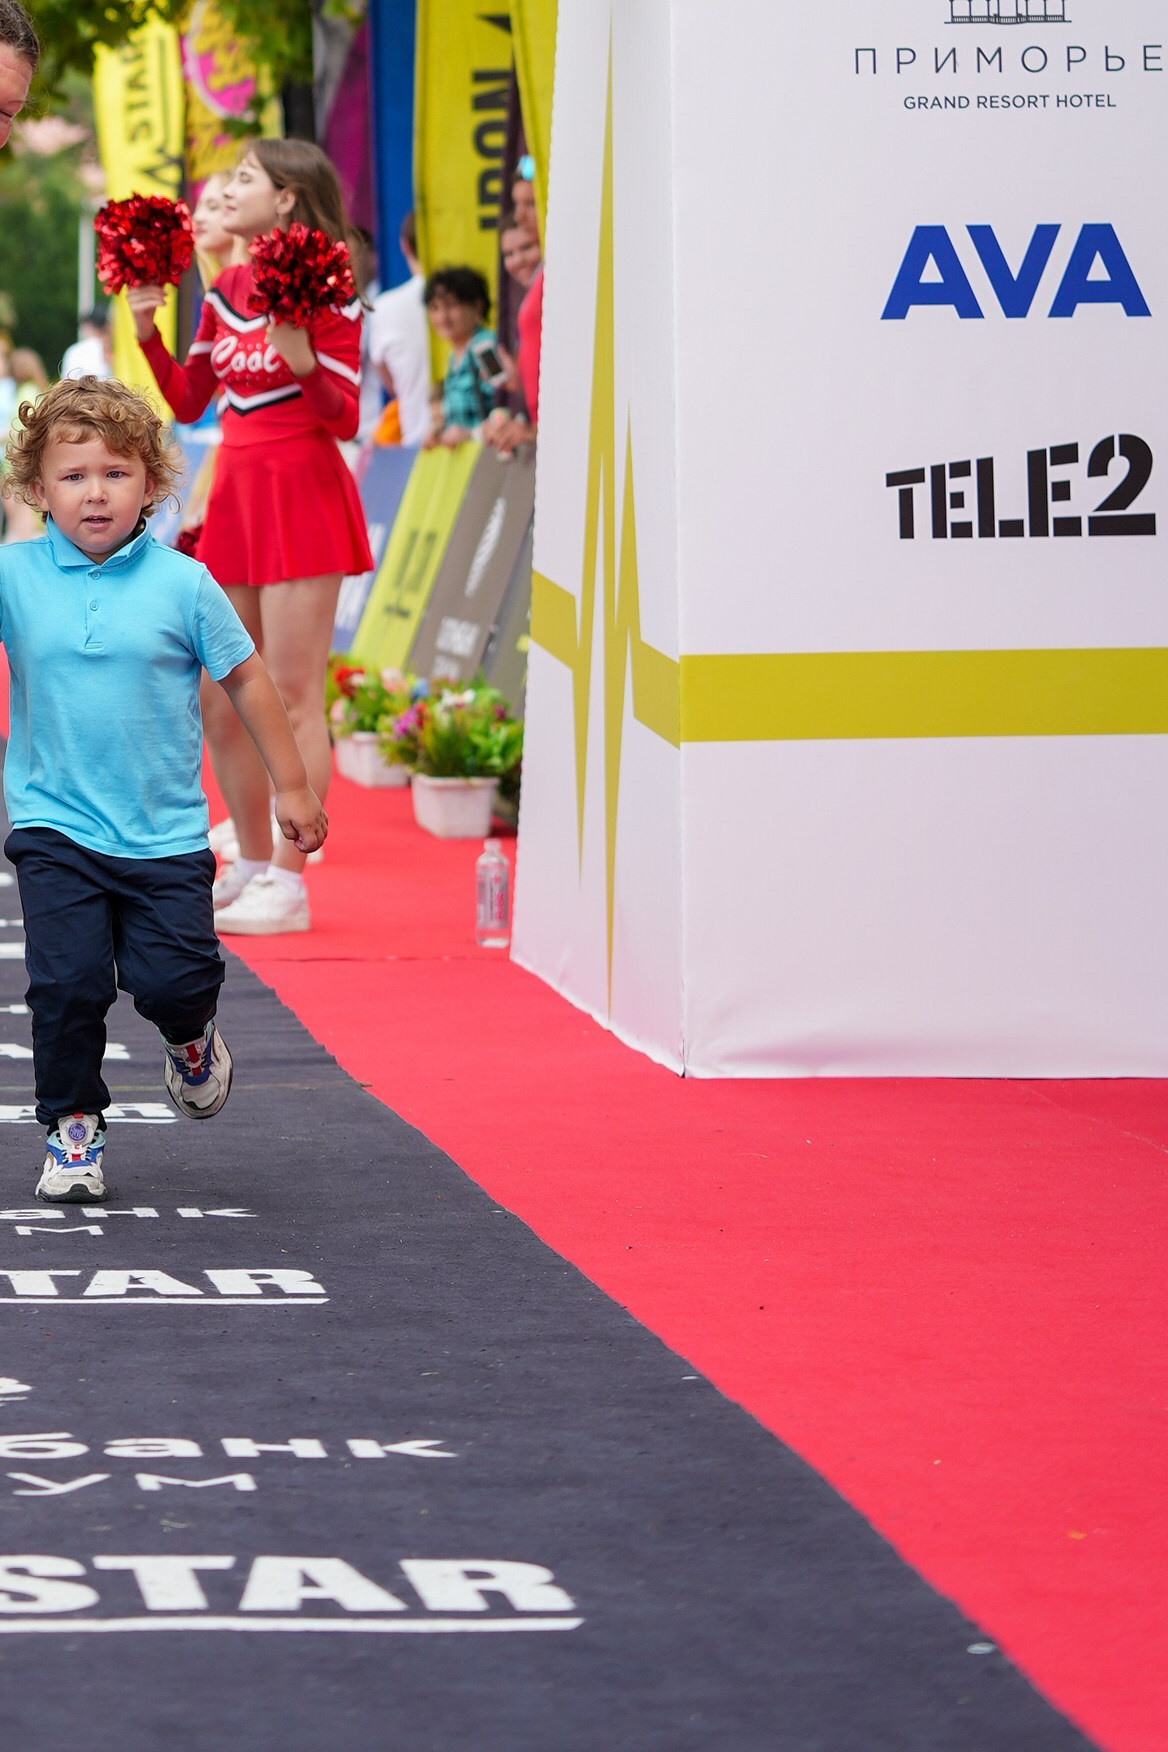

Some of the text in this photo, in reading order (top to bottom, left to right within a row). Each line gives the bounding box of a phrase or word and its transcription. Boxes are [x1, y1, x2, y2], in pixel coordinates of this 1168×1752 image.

[854, 44, 1164, 75] ПРИМОРЬЕ
[903, 93, 1117, 111] GRAND RESORT HOTEL
[879, 222, 1153, 320] AVA
[210, 335, 282, 380] Cool
[885, 433, 1157, 539] TELE2
